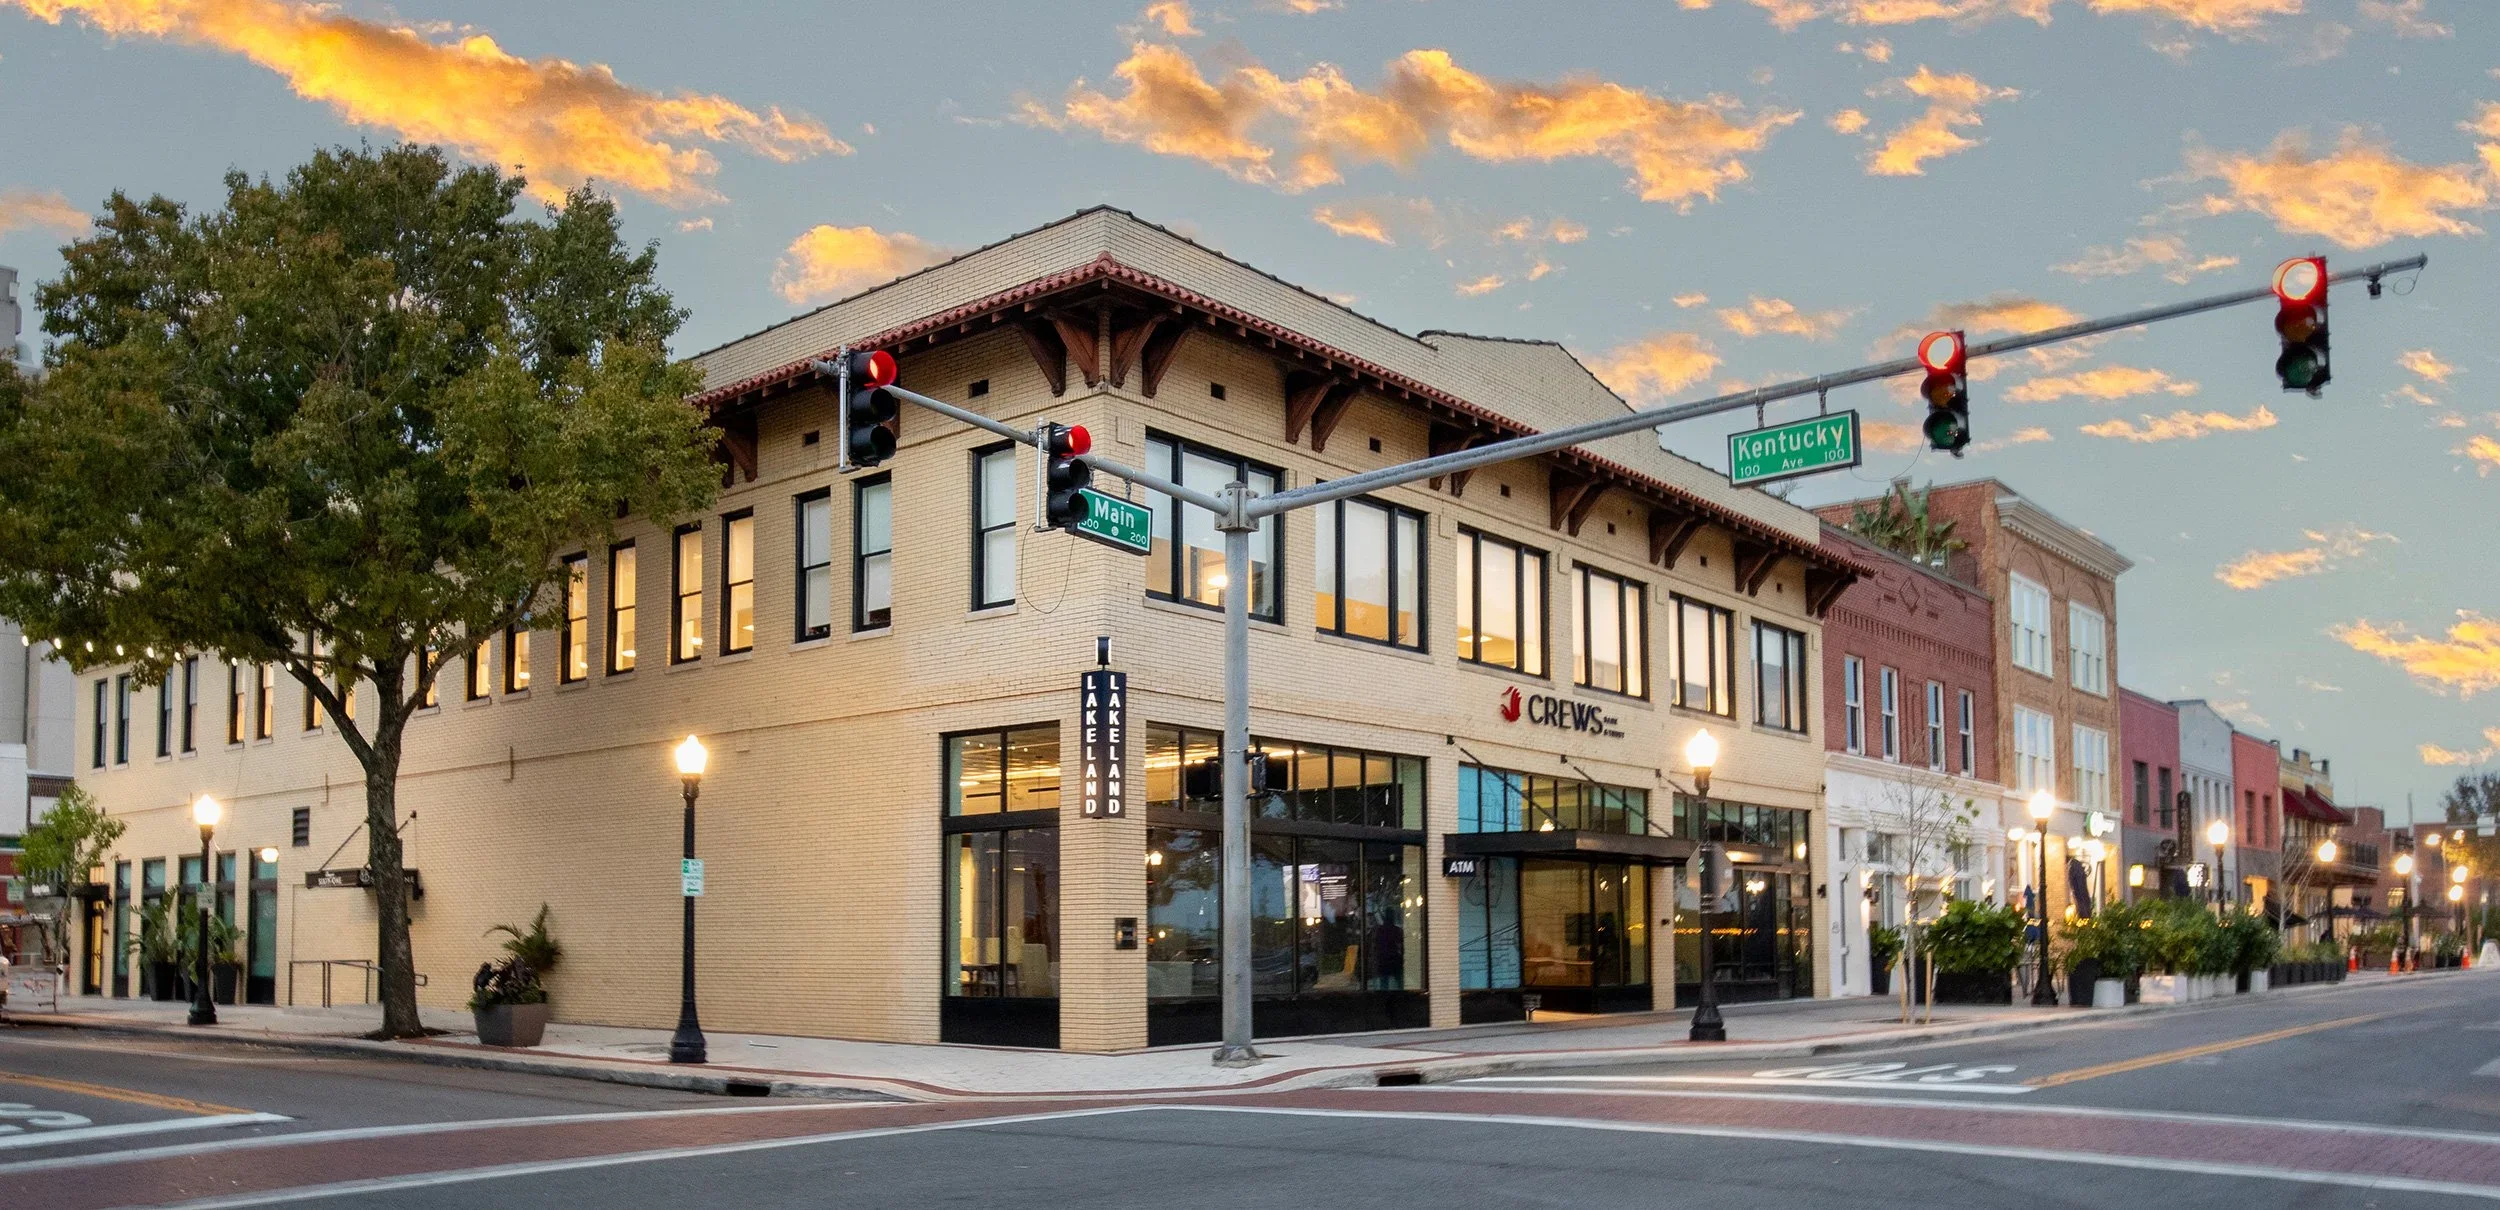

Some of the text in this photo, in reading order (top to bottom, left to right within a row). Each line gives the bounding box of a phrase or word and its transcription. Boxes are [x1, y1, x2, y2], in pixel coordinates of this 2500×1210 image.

[1738, 424, 1844, 462] Kentucky
[1740, 449, 1845, 477] 100 Ave 100
[1094, 497, 1135, 529] Main
[1130, 532, 1147, 545] 200
[1528, 694, 1604, 735] CREWS
[1085, 674, 1098, 815] LAKELAND
[1108, 674, 1121, 815] LAKELAND
[1449, 860, 1475, 873] ATM
